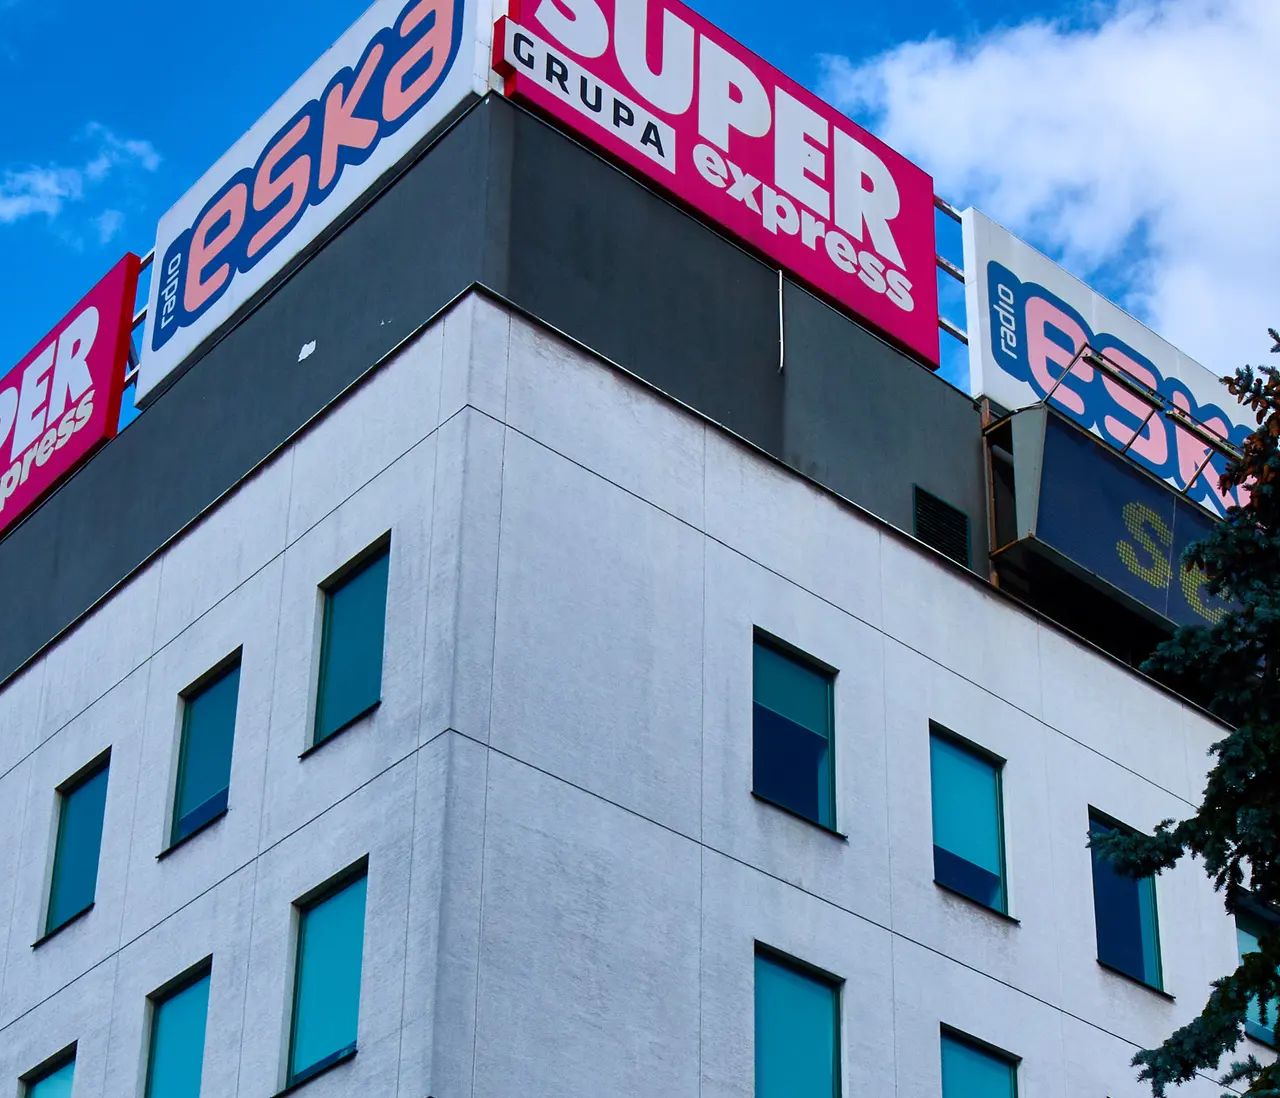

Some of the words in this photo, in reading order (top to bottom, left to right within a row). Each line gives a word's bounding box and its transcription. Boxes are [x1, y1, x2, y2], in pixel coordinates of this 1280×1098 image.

[184, 0, 454, 312] eska
[513, 32, 665, 158] GRUPA
[161, 253, 181, 329] radio
[693, 144, 914, 312] express
[993, 284, 1017, 359] radio
[1025, 296, 1258, 508] esk
